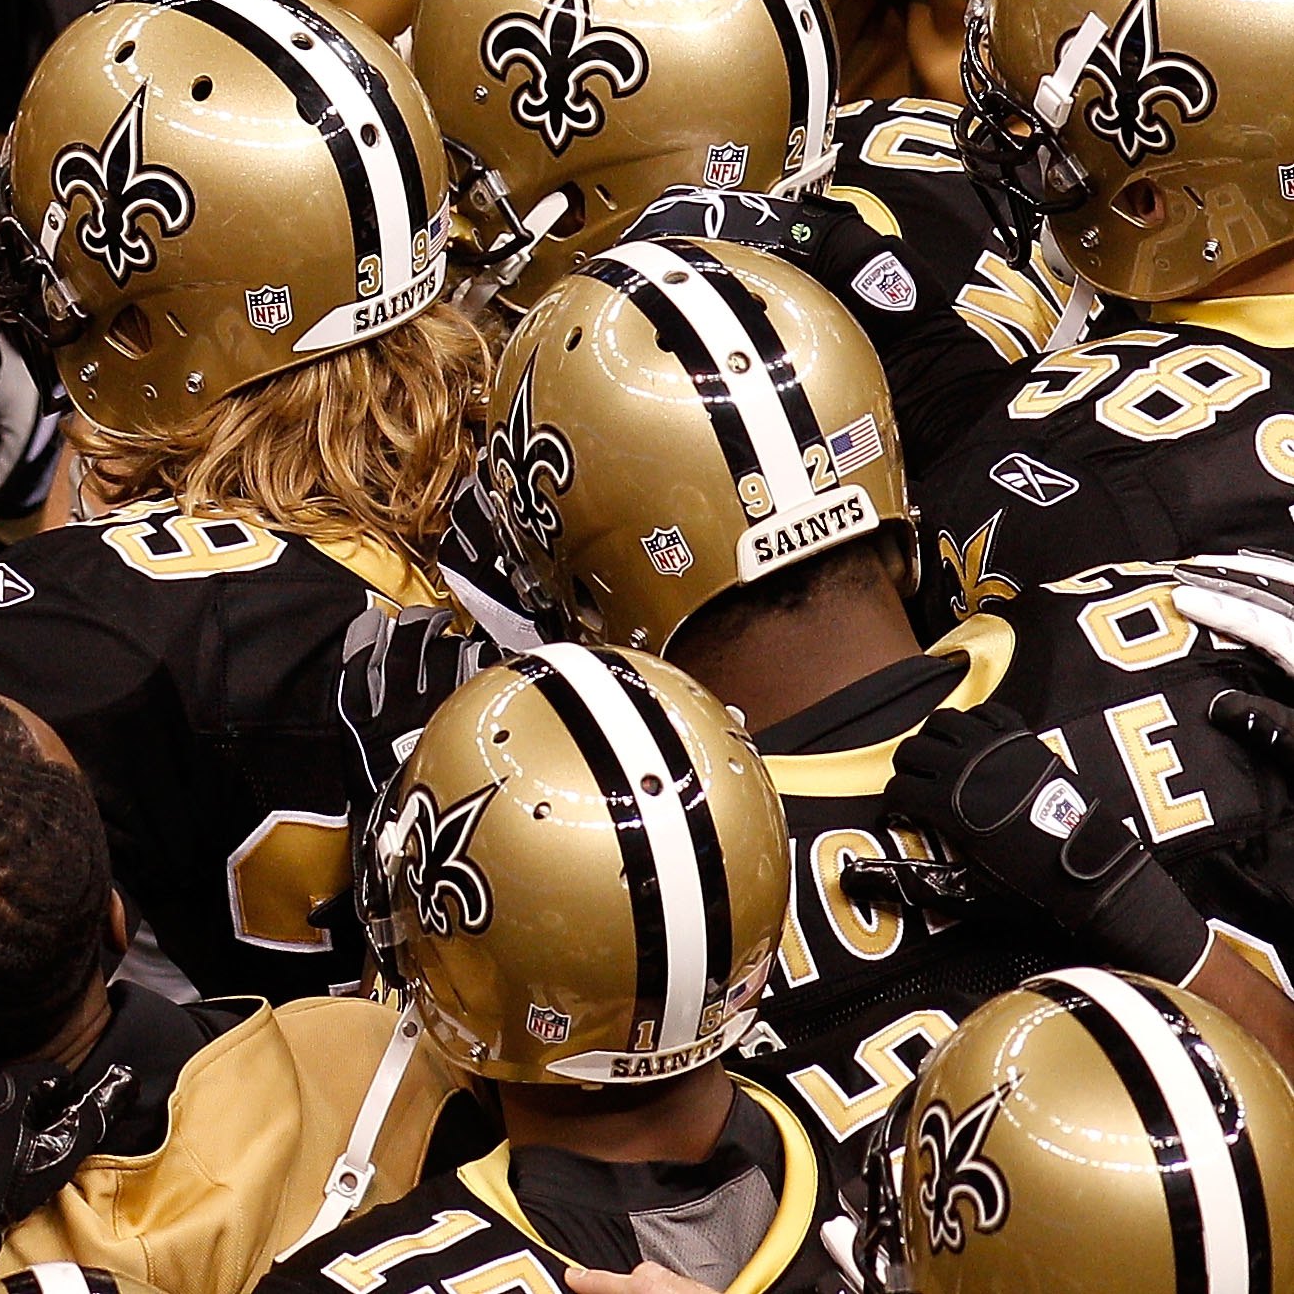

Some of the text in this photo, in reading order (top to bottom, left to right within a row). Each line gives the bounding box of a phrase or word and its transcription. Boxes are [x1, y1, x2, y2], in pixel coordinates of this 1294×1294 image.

[711, 161, 740, 185] NFL
[357, 228, 430, 297] 3 9
[354, 272, 437, 333] SAINTS
[888, 282, 911, 305] NFL
[254, 303, 288, 325] NFL
[737, 444, 838, 518] 9 2
[754, 494, 864, 564] SAINTS
[655, 547, 687, 573] NFL
[531, 1016, 564, 1038] NFL
[634, 1020, 656, 1051] 1
[612, 1033, 725, 1078] SAINTS
